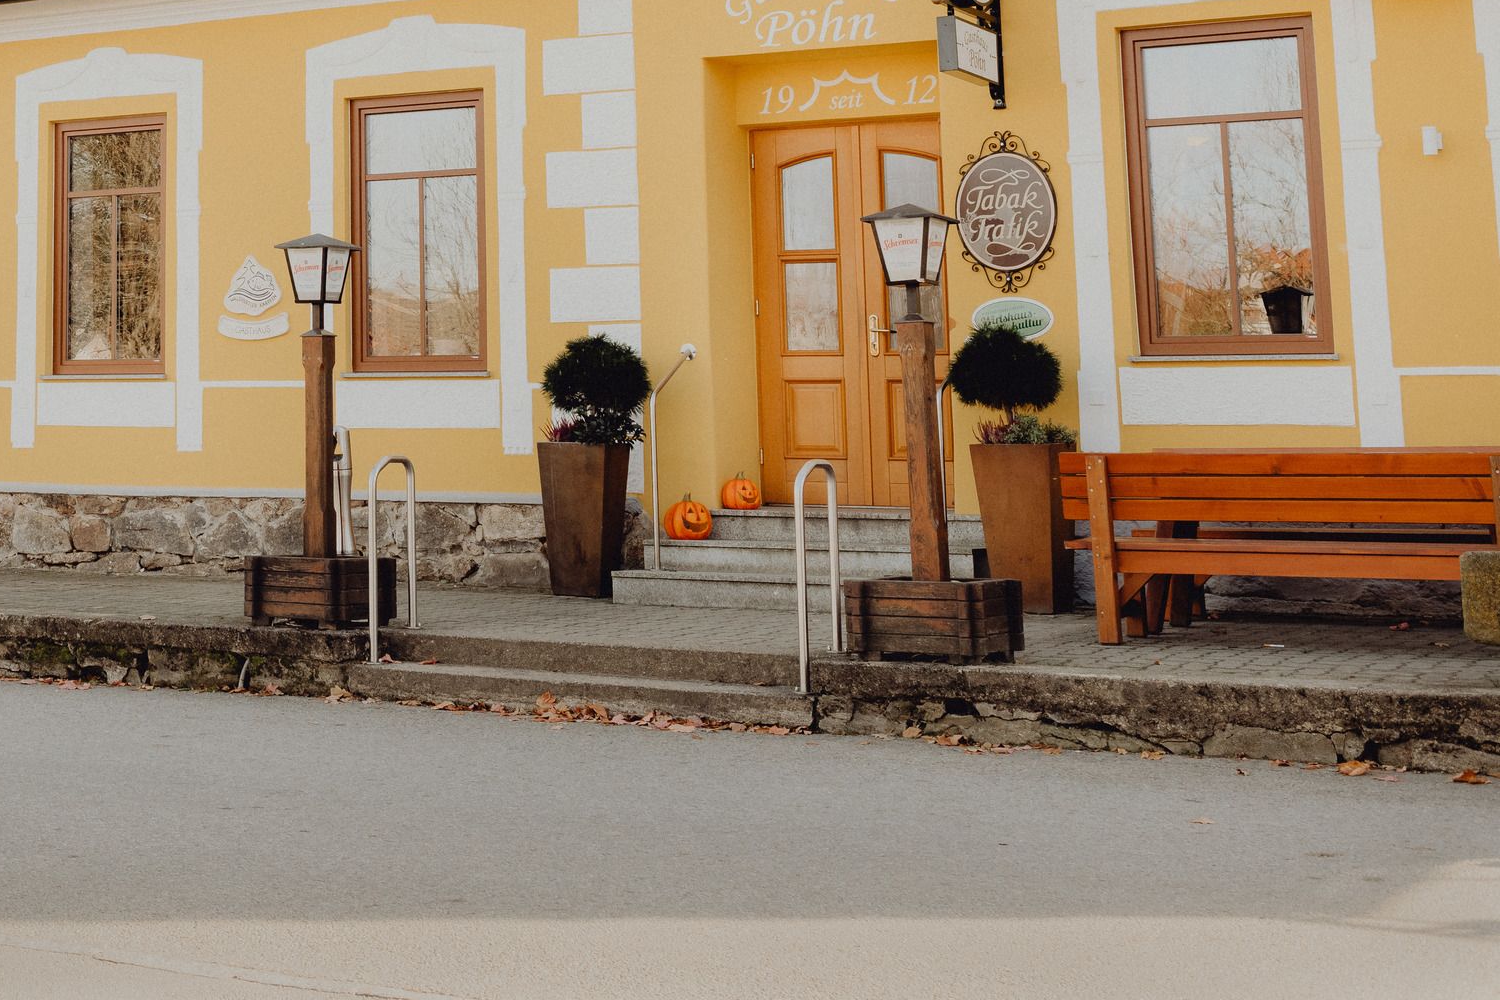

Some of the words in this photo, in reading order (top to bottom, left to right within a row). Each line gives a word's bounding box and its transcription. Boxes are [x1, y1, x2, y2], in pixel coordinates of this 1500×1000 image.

[755, 0, 877, 48] Pöhn
[758, 85, 795, 115] 19
[828, 89, 863, 111] seit
[902, 74, 938, 106] 12
[966, 180, 1044, 215] Tabak
[969, 210, 1045, 245] Trafik
